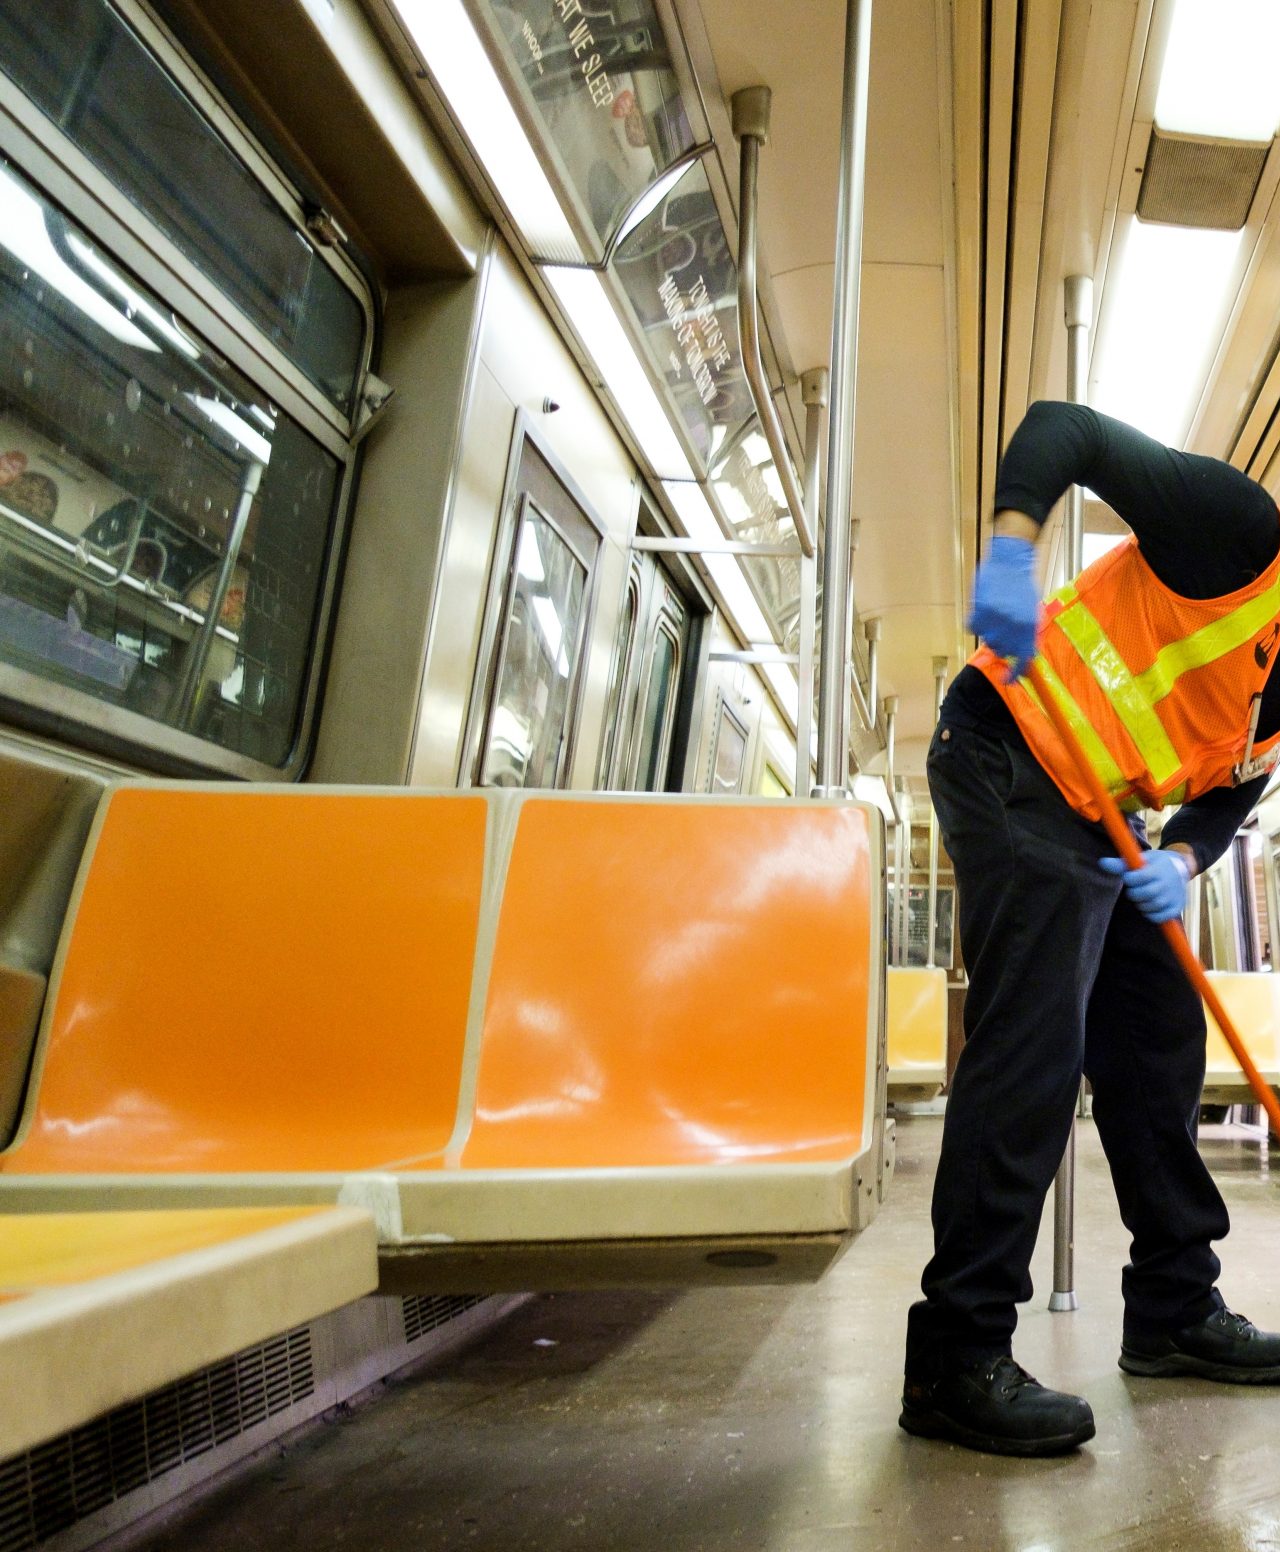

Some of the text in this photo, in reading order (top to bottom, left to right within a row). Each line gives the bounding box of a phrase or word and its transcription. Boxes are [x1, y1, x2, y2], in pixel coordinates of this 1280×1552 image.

[522, 20, 543, 61] WHOOP
[555, 0, 614, 109] AT WE SLEEP
[658, 274, 718, 405] MAKING OF TOMORROW
[689, 274, 731, 371] TONIGHT IS THE
